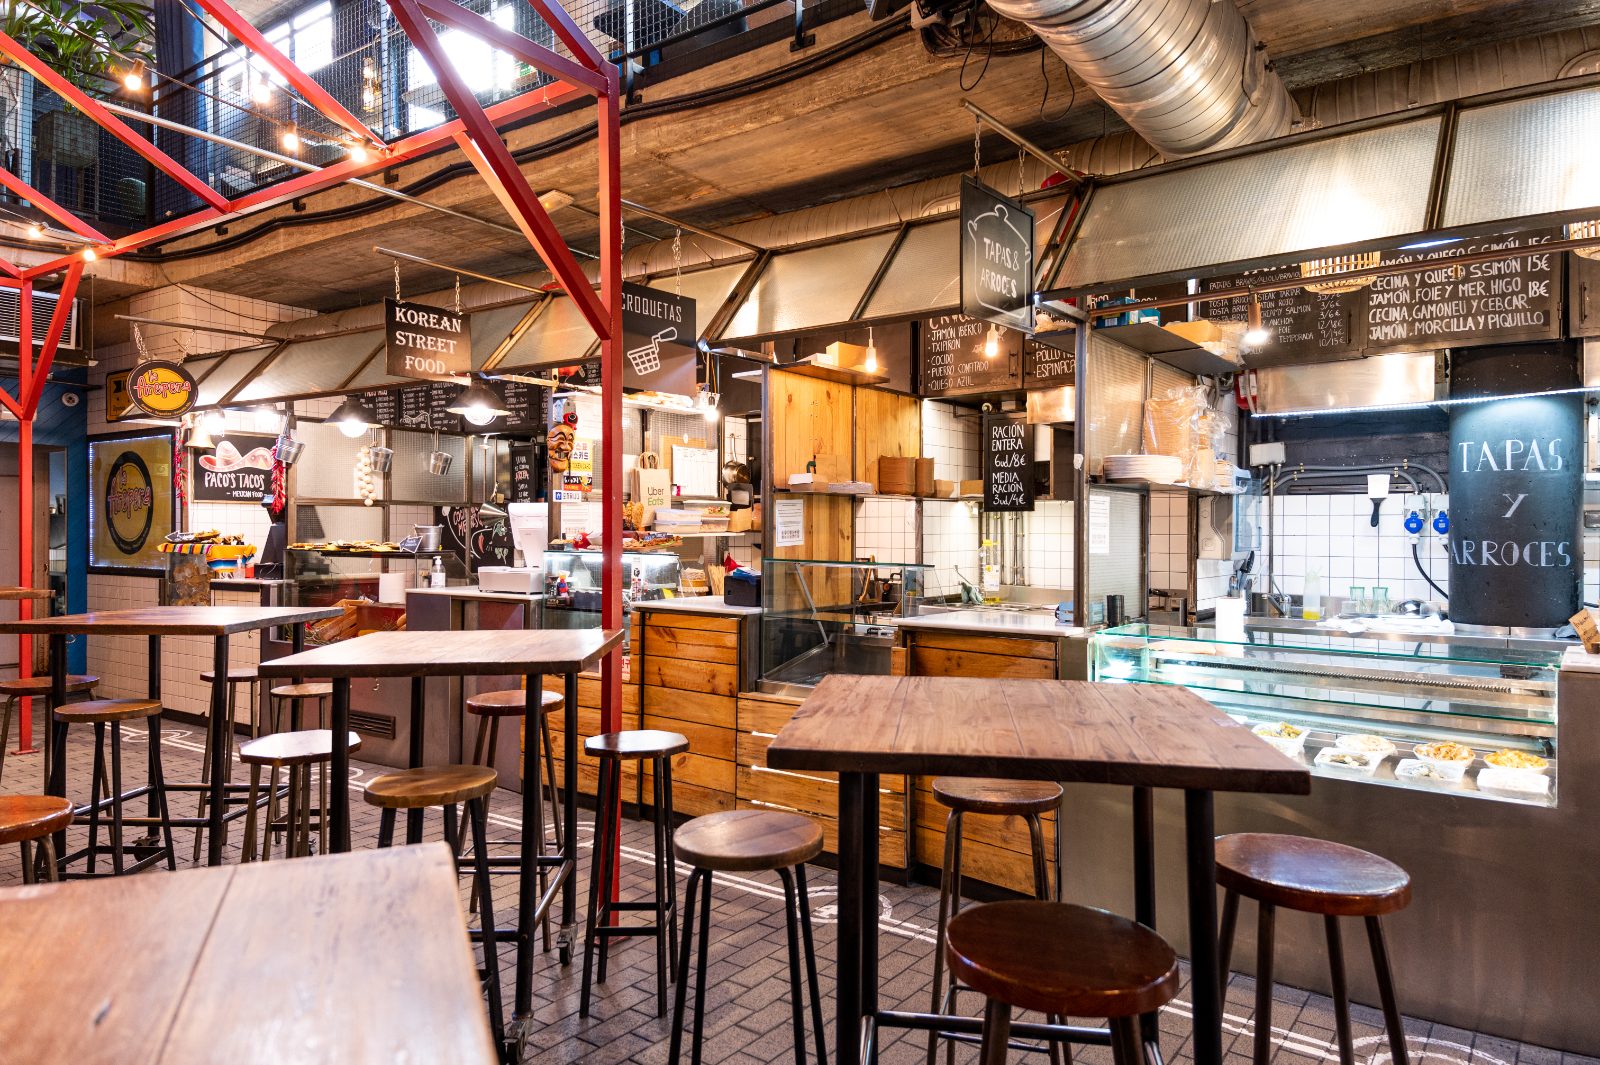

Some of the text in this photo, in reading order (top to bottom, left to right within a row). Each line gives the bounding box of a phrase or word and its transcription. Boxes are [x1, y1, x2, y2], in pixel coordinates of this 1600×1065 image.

[983, 237, 1020, 272] TAPAS &
[1370, 274, 1410, 291] CECINA
[1414, 272, 1422, 287] Y
[1527, 254, 1551, 272] 15€
[980, 267, 1017, 298] ARROCES
[1444, 284, 1454, 298] Y
[1528, 280, 1550, 298] 18€
[621, 293, 682, 323] CROQUETAS
[1470, 299, 1478, 314] Y
[395, 306, 462, 334] KOREAN
[1476, 315, 1485, 330] Y
[1487, 311, 1545, 330] PIQUILLO
[395, 330, 457, 354] STREET
[405, 355, 446, 375] FOOD
[930, 353, 954, 366] COCIDO
[930, 375, 975, 391] QUESO AZUL
[992, 421, 1025, 439] RACIÓN
[991, 438, 1024, 452] ENTERA
[1458, 438, 1563, 473] TAPAS
[236, 473, 265, 490] TACOS
[992, 471, 1019, 484] MEDIA
[232, 490, 252, 498] MEXICAN
[647, 486, 664, 496] Uber
[992, 481, 1024, 494] RACIÓN
[647, 497, 664, 506] Eats
[1501, 493, 1529, 518] Y
[1449, 539, 1571, 567] ARROCES
